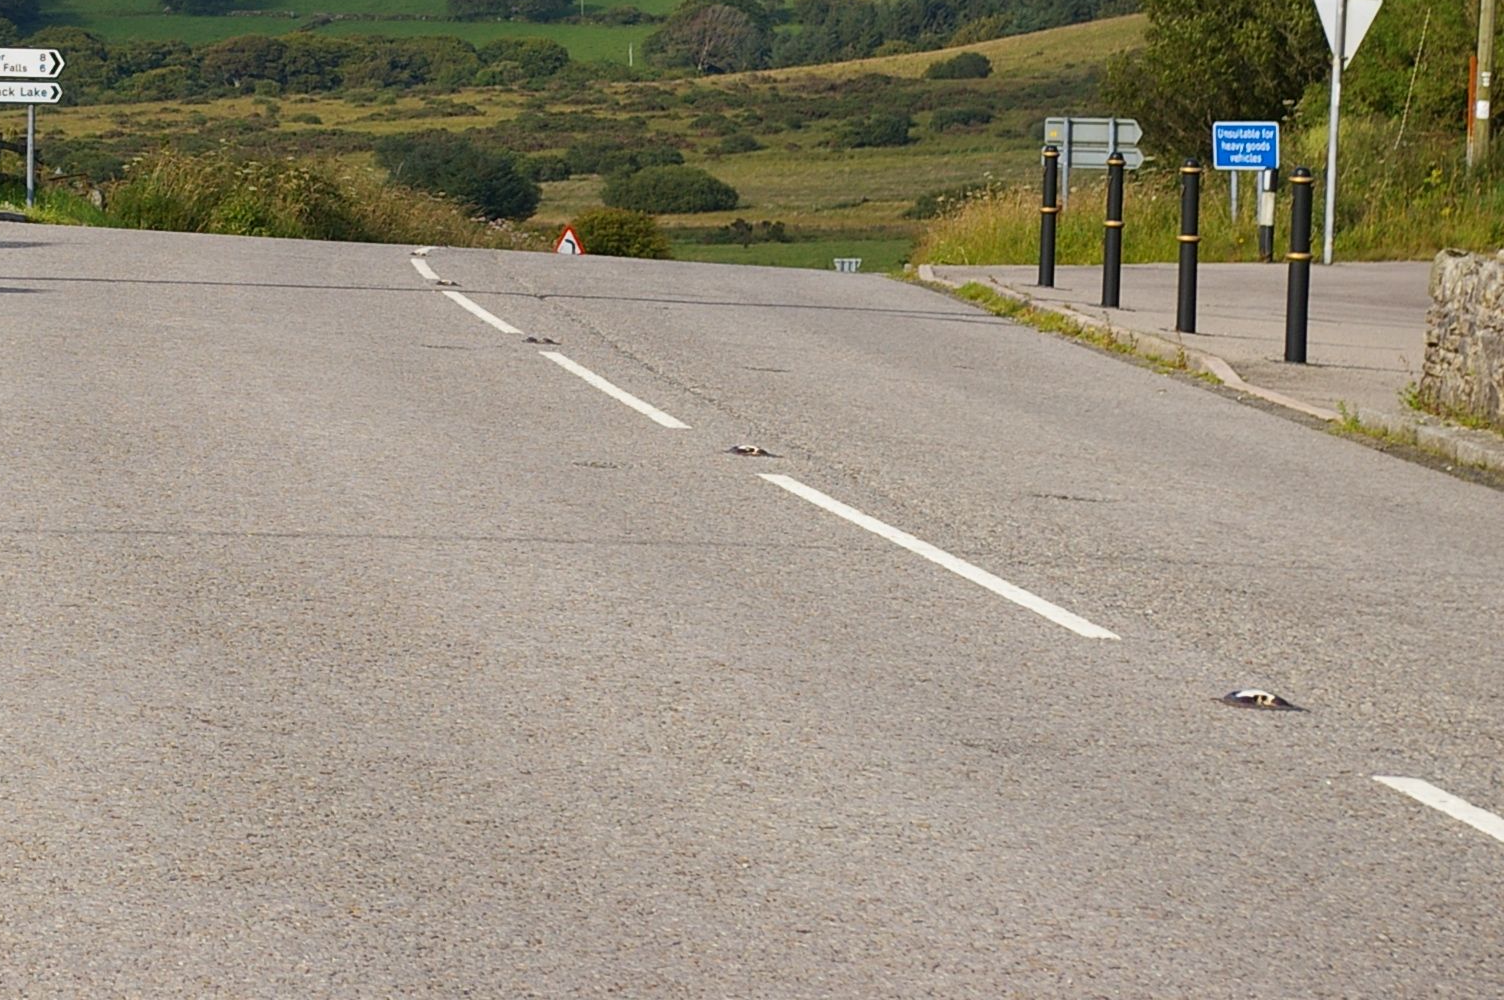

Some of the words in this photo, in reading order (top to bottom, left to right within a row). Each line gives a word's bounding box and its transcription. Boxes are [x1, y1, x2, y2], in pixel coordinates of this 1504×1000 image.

[39, 53, 46, 62] 8
[3, 63, 28, 72] Falls
[39, 64, 46, 73] 6
[20, 87, 48, 97] Lake
[1217, 128, 1260, 139] Unsuitable
[1261, 128, 1274, 139] for
[1221, 140, 1244, 153] heavy
[1245, 140, 1271, 153] goods
[1229, 153, 1262, 163] vehicles
